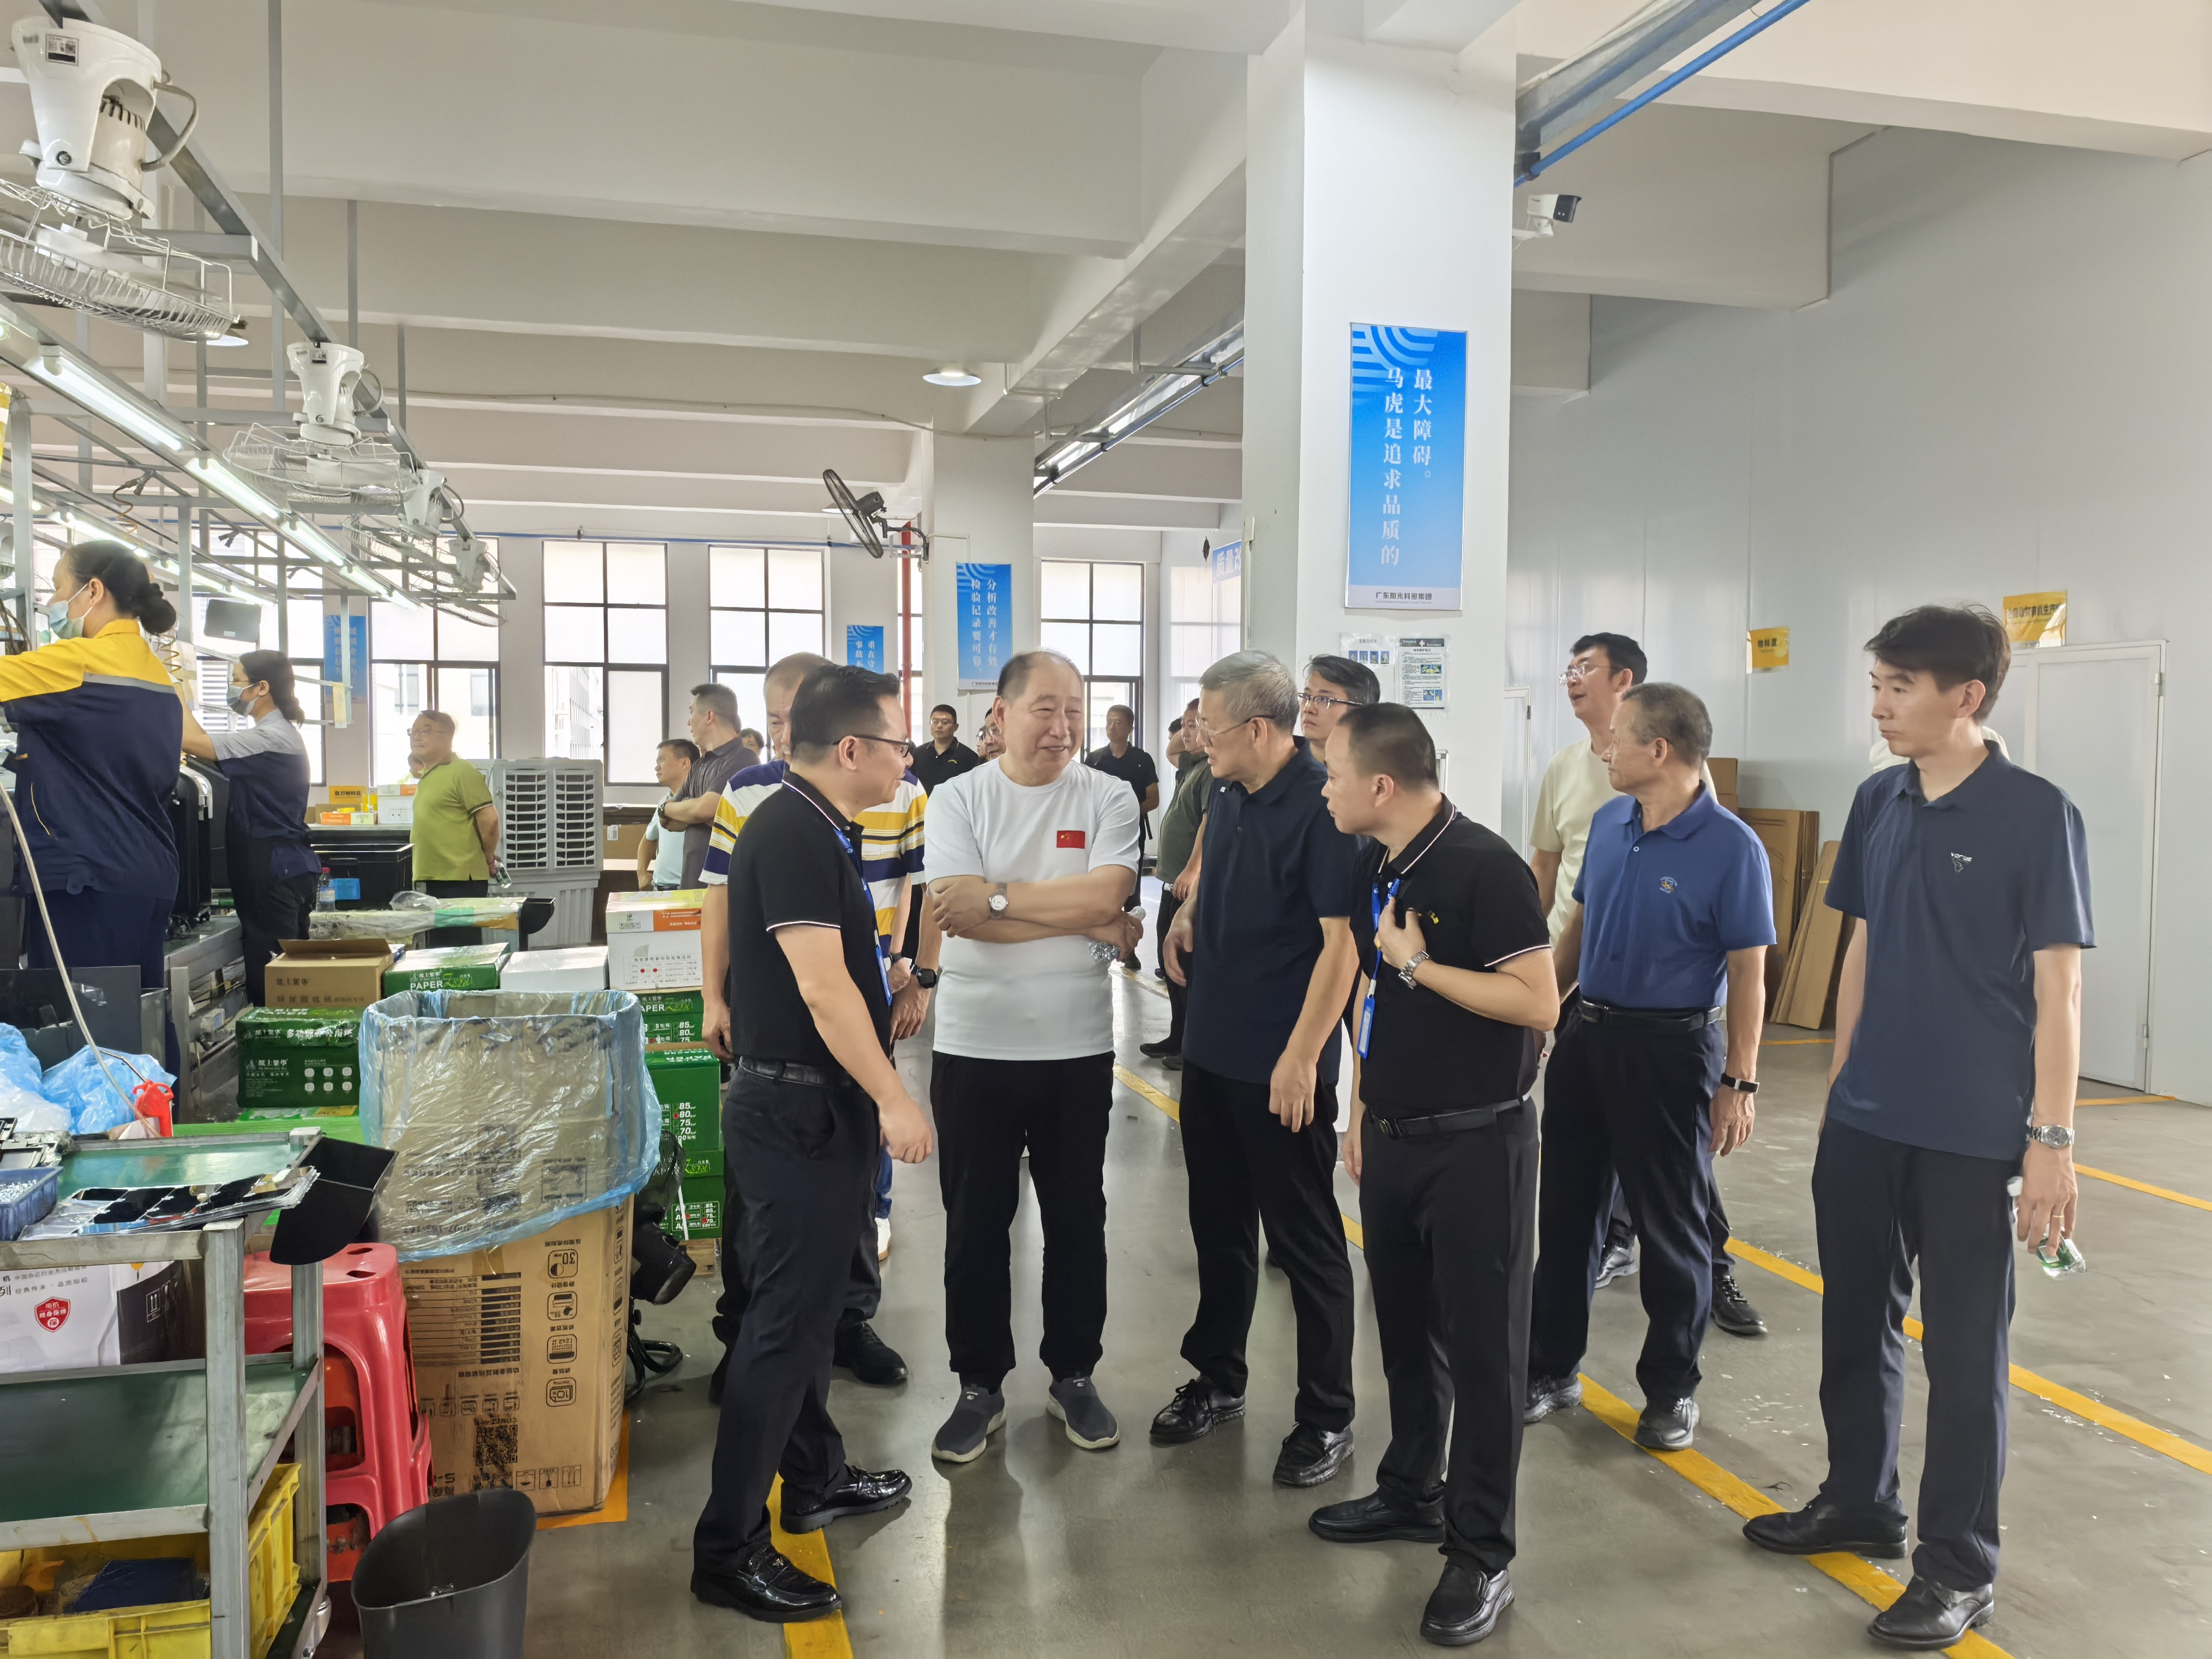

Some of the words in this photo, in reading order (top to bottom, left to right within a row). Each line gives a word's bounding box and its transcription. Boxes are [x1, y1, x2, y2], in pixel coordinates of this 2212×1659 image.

[1413, 368, 1433, 478] 最大障碍。
[1381, 367, 1404, 565] 马虎是追求品质的
[410, 980, 443, 992] PAPER
[640, 1004, 665, 1013] APER
[562, 1252, 576, 1265] 30
